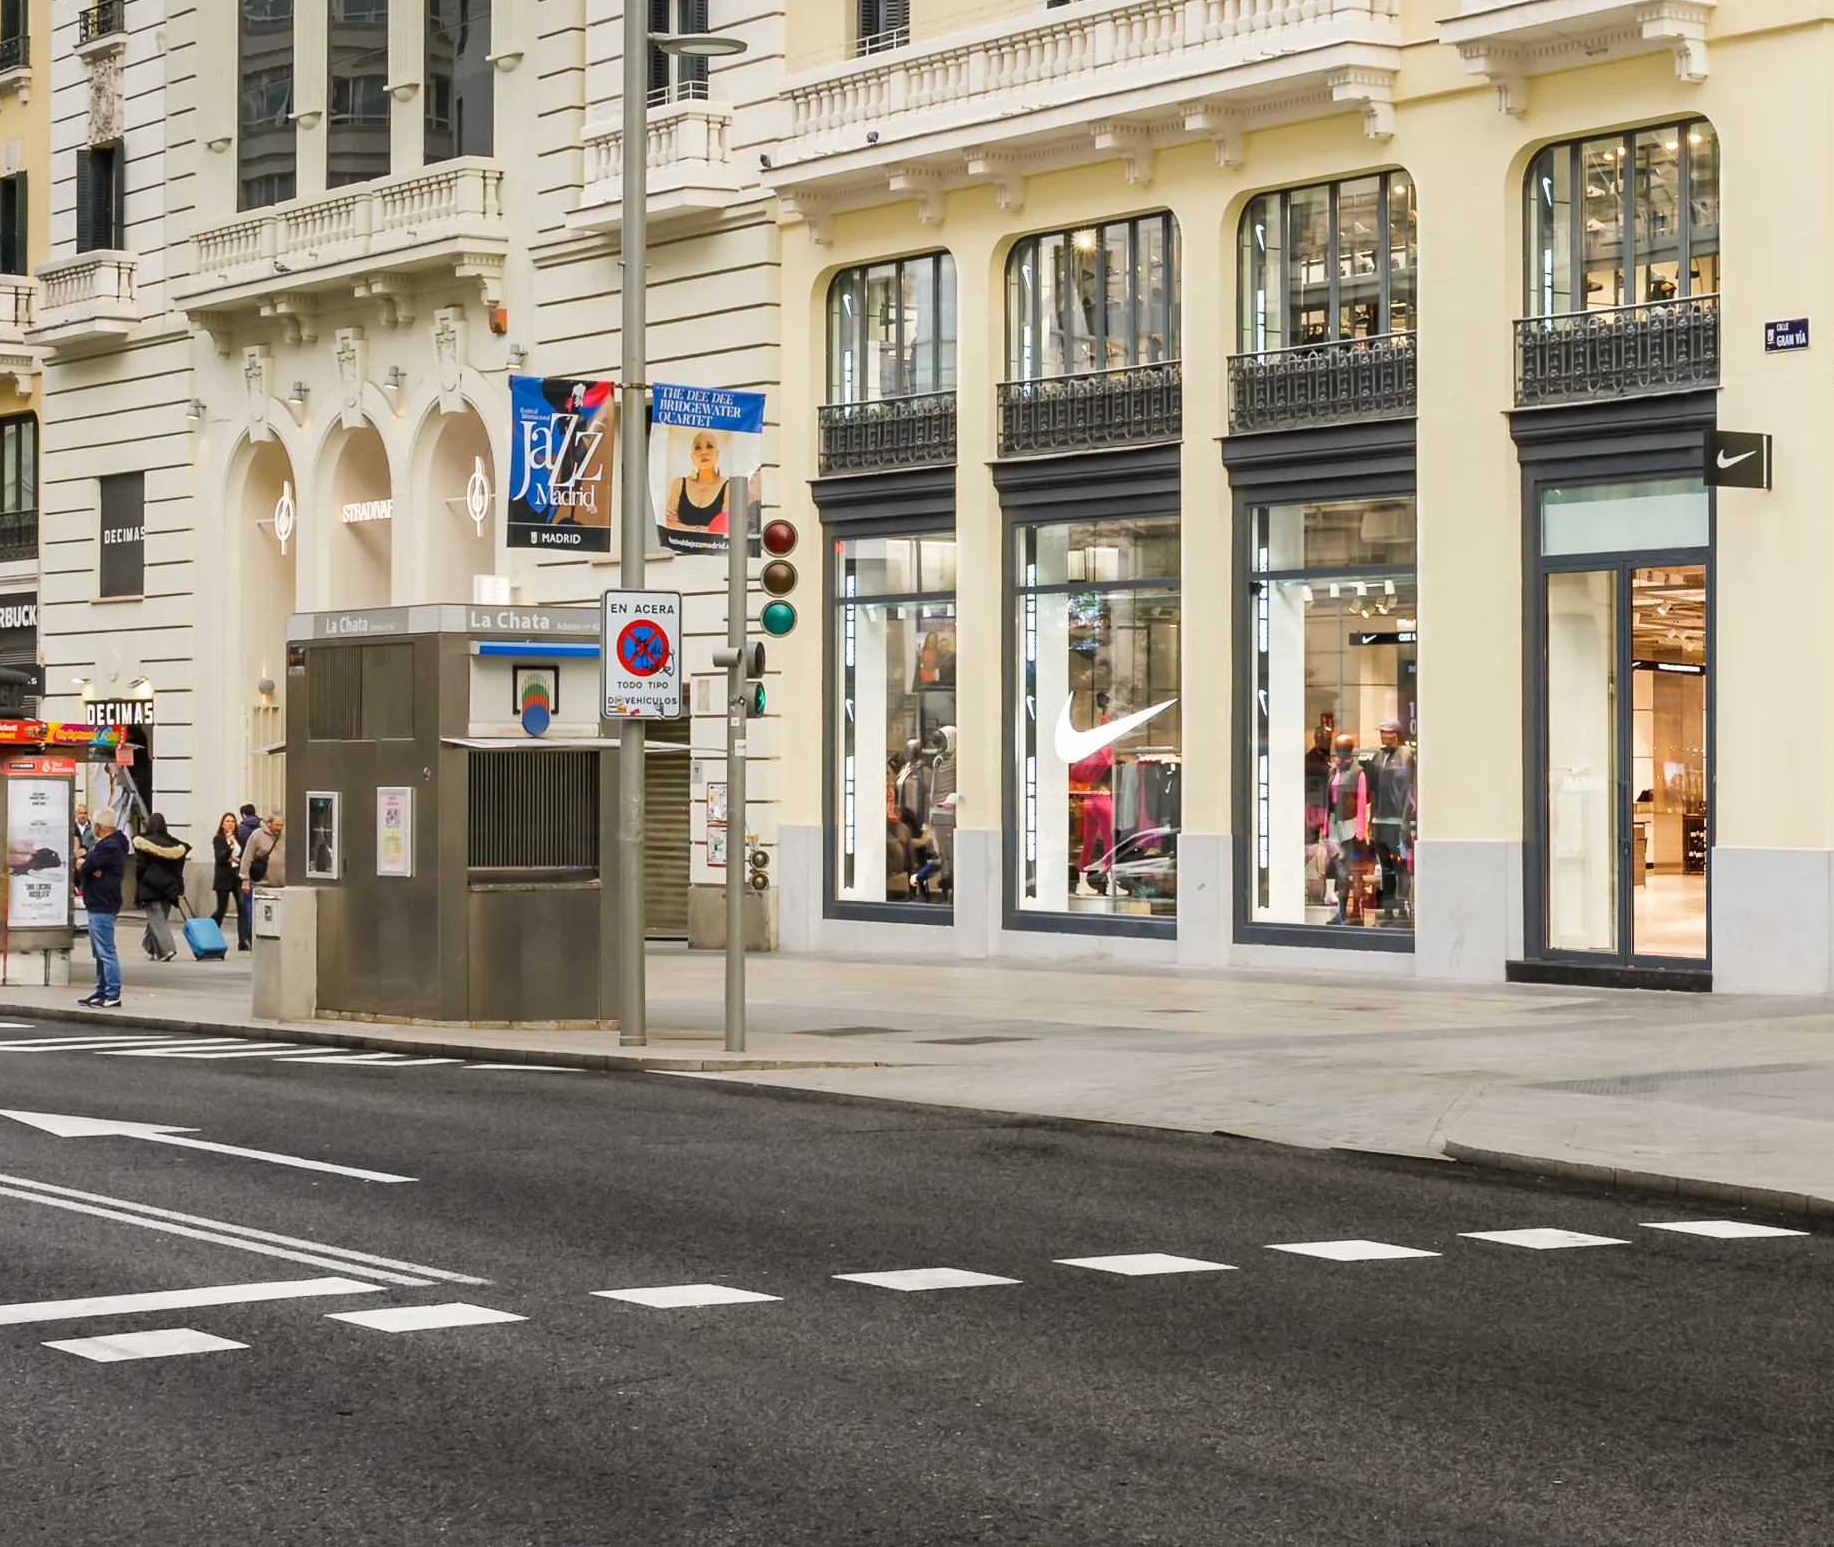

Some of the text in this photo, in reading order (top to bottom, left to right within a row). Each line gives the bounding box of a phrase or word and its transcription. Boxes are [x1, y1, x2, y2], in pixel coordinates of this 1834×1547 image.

[1776, 334, 1795, 347] GRAN
[660, 387, 734, 405] THE DEE DEE
[659, 399, 741, 419] BRIDGEWATER
[658, 411, 713, 428] QUARTET
[535, 483, 596, 507] Madrid
[104, 525, 146, 546] DECIMAS
[541, 532, 581, 544] MADRID
[610, 603, 675, 615] EN ACERA
[326, 617, 339, 634] La
[339, 615, 369, 632] Chata
[471, 611, 491, 629] La
[497, 611, 551, 629] Chata
[617, 681, 643, 689] TODO
[624, 696, 678, 705] VEHÍCULOS
[86, 702, 154, 726] DECIMAS
